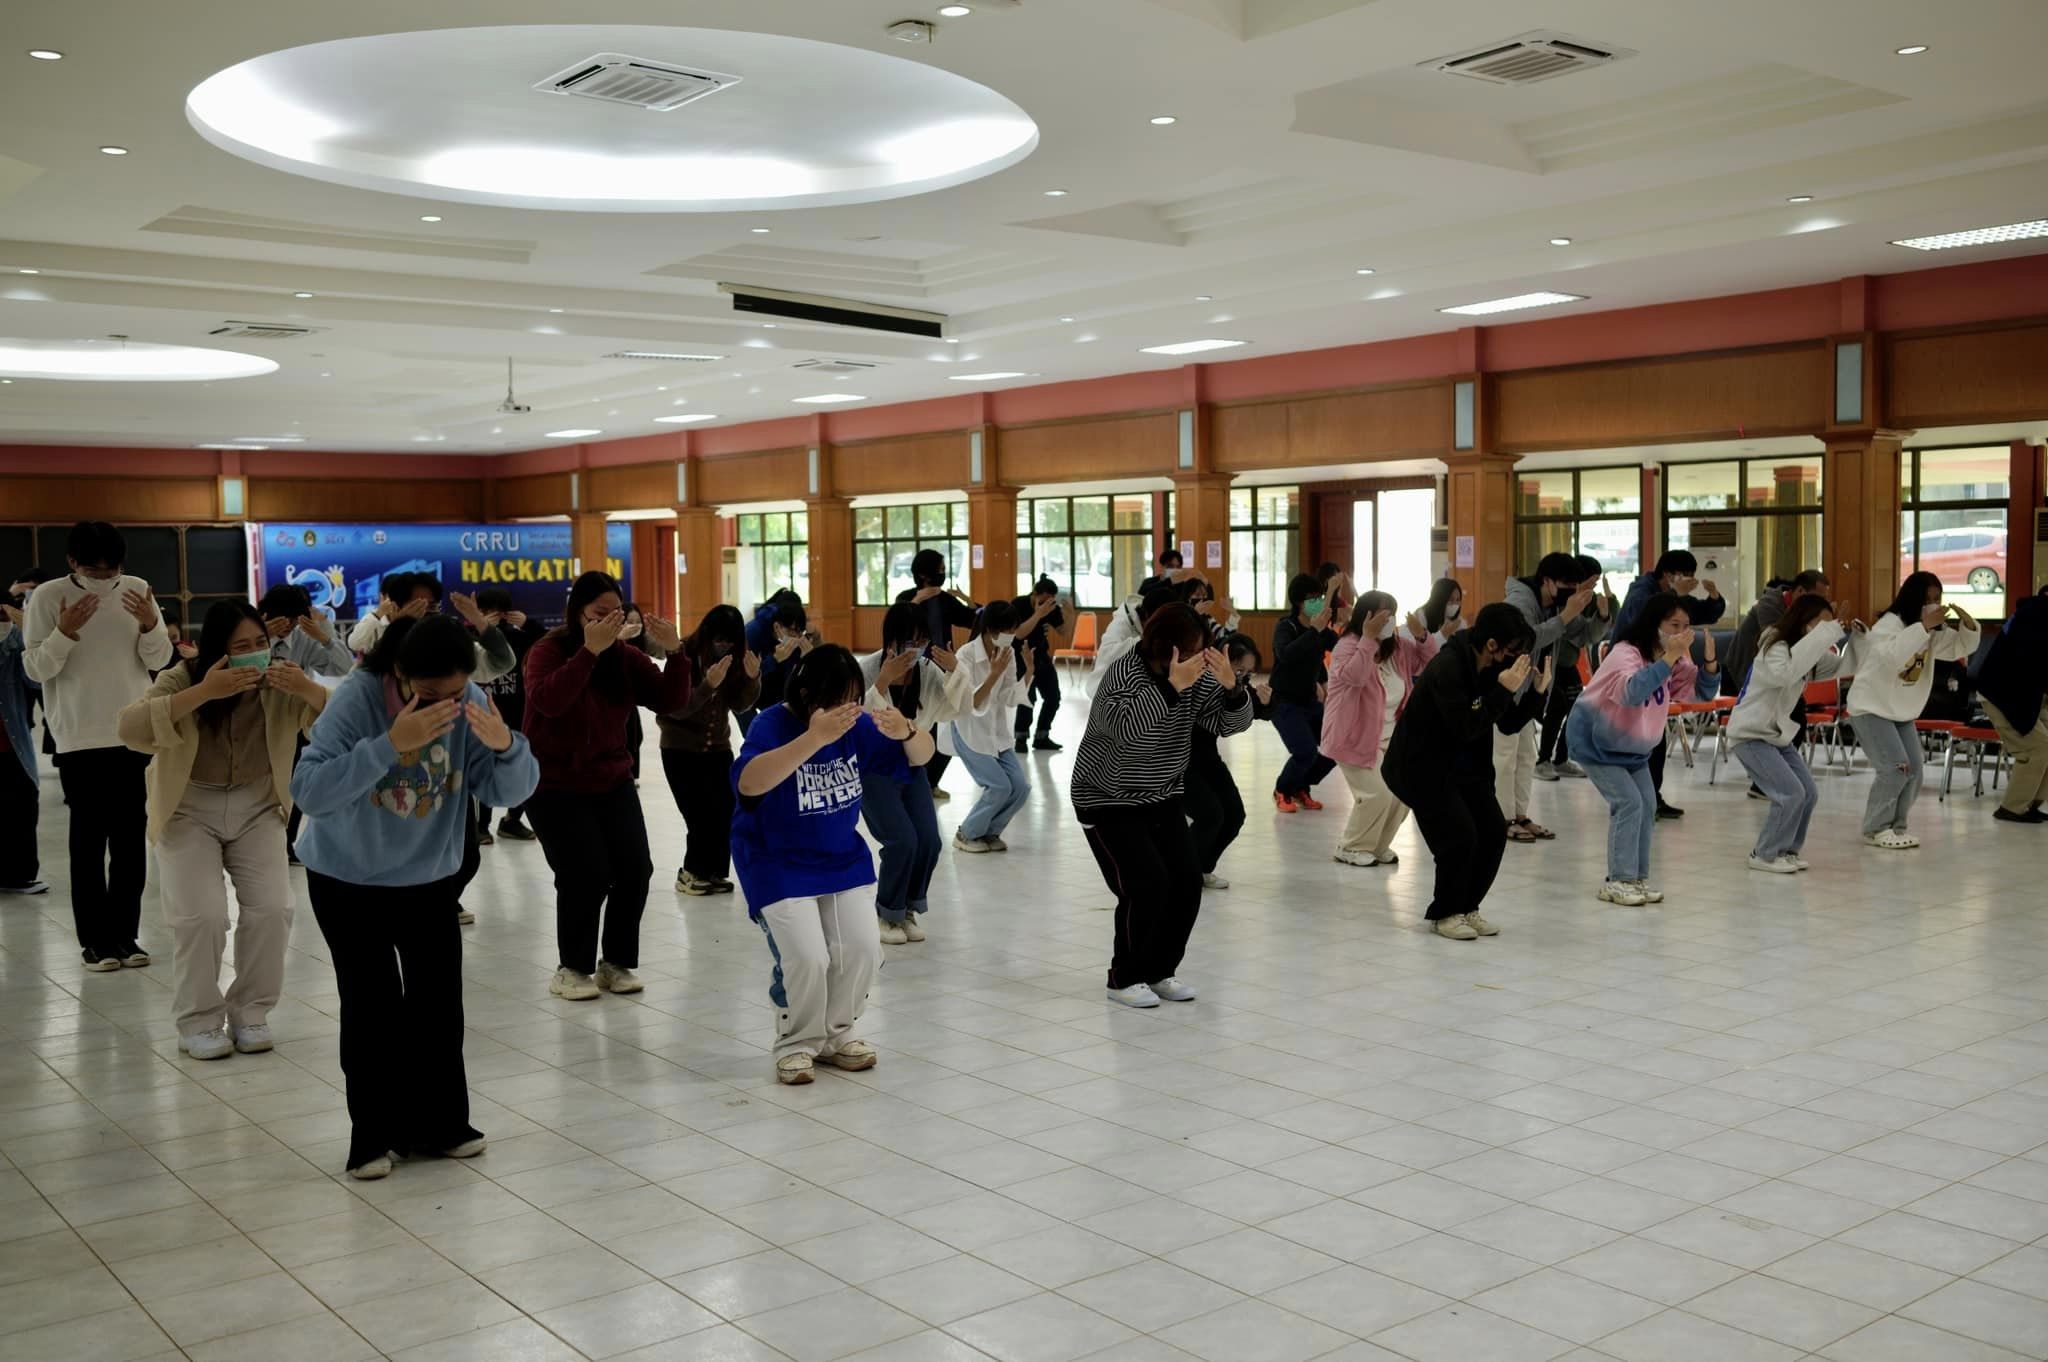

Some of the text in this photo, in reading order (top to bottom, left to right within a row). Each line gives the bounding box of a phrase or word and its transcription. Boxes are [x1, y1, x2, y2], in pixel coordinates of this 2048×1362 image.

[460, 531, 520, 552] CRRU
[461, 557, 623, 583] HACKATN
[798, 778, 863, 811] METERS
